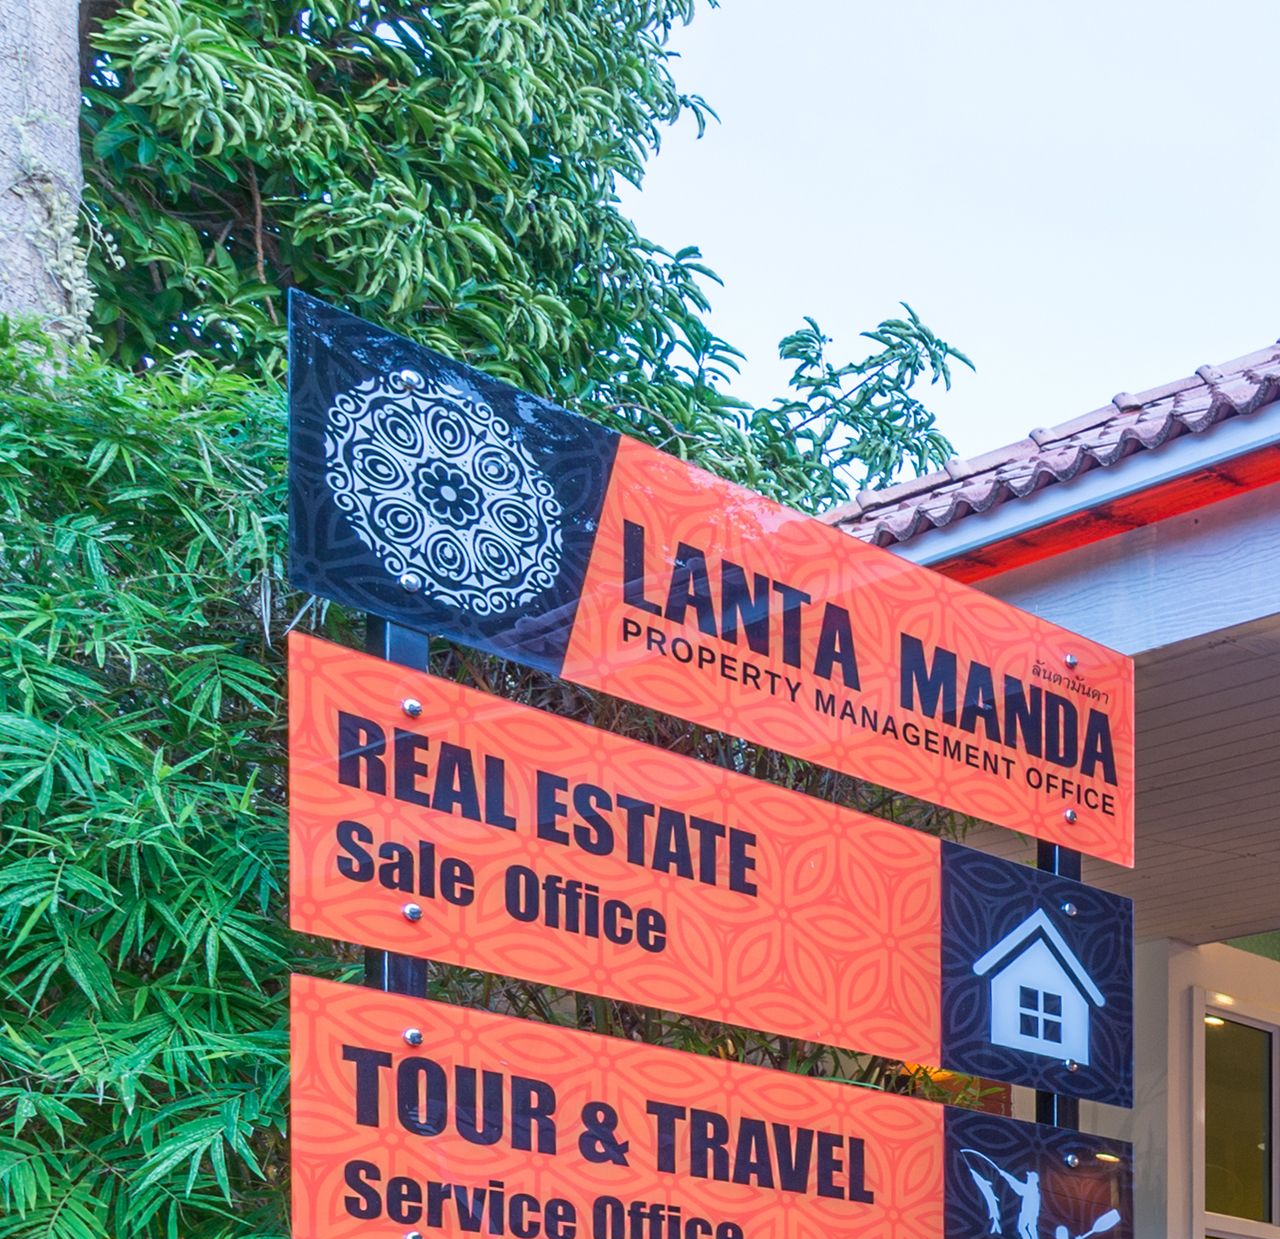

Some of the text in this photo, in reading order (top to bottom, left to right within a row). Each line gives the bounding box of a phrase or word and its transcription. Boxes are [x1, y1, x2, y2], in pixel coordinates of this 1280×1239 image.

[623, 519, 1118, 787] LANTA MANDA
[623, 618, 1115, 817] PROPERTY MANAGEMENT OFFICE
[336, 820, 667, 953] Sale Office
[338, 710, 758, 897] REAL ESTATE
[342, 1044, 875, 1204] TOUR & TRAVEL
